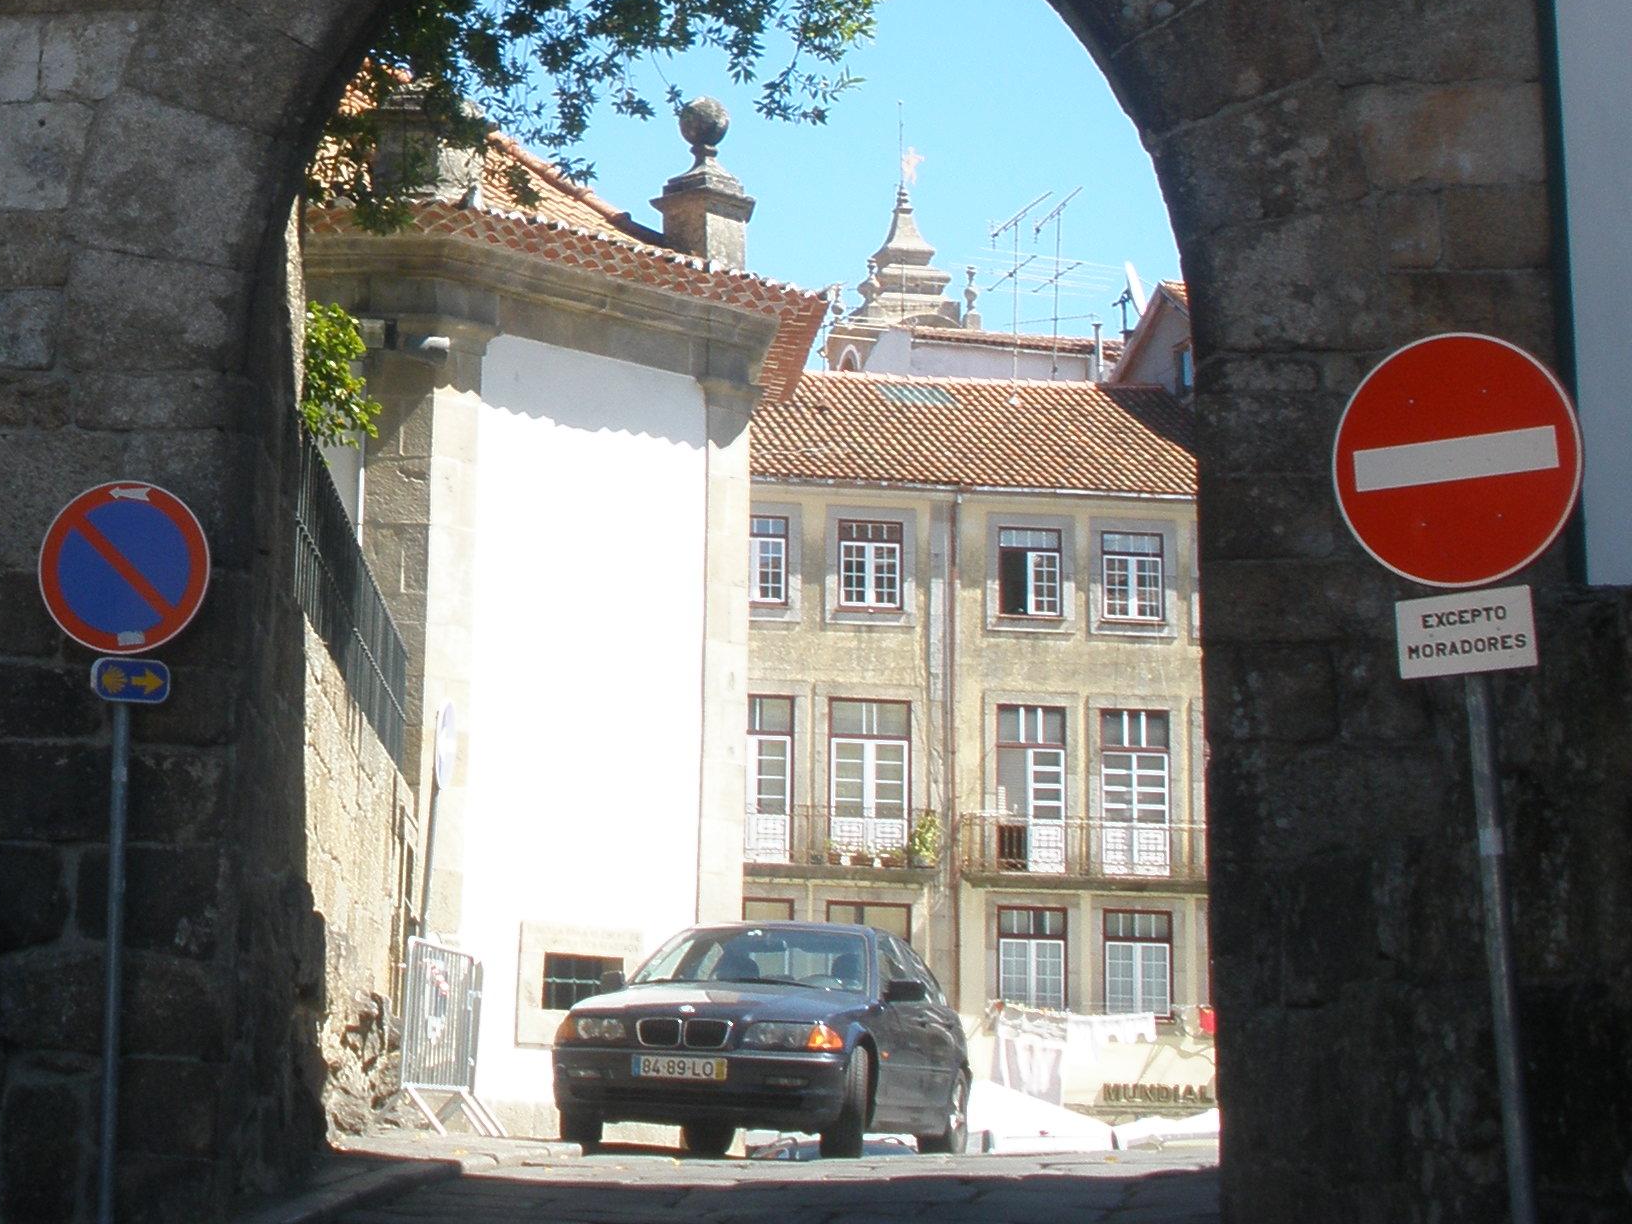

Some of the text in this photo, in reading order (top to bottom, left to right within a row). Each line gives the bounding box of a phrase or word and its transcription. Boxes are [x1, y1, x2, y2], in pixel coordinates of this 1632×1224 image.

[1421, 605, 1507, 629] EXCEPTO
[1407, 633, 1527, 660] MORADORES
[642, 1058, 714, 1077] 84-89-LO
[1103, 1083, 1214, 1104] MUNDIAL
